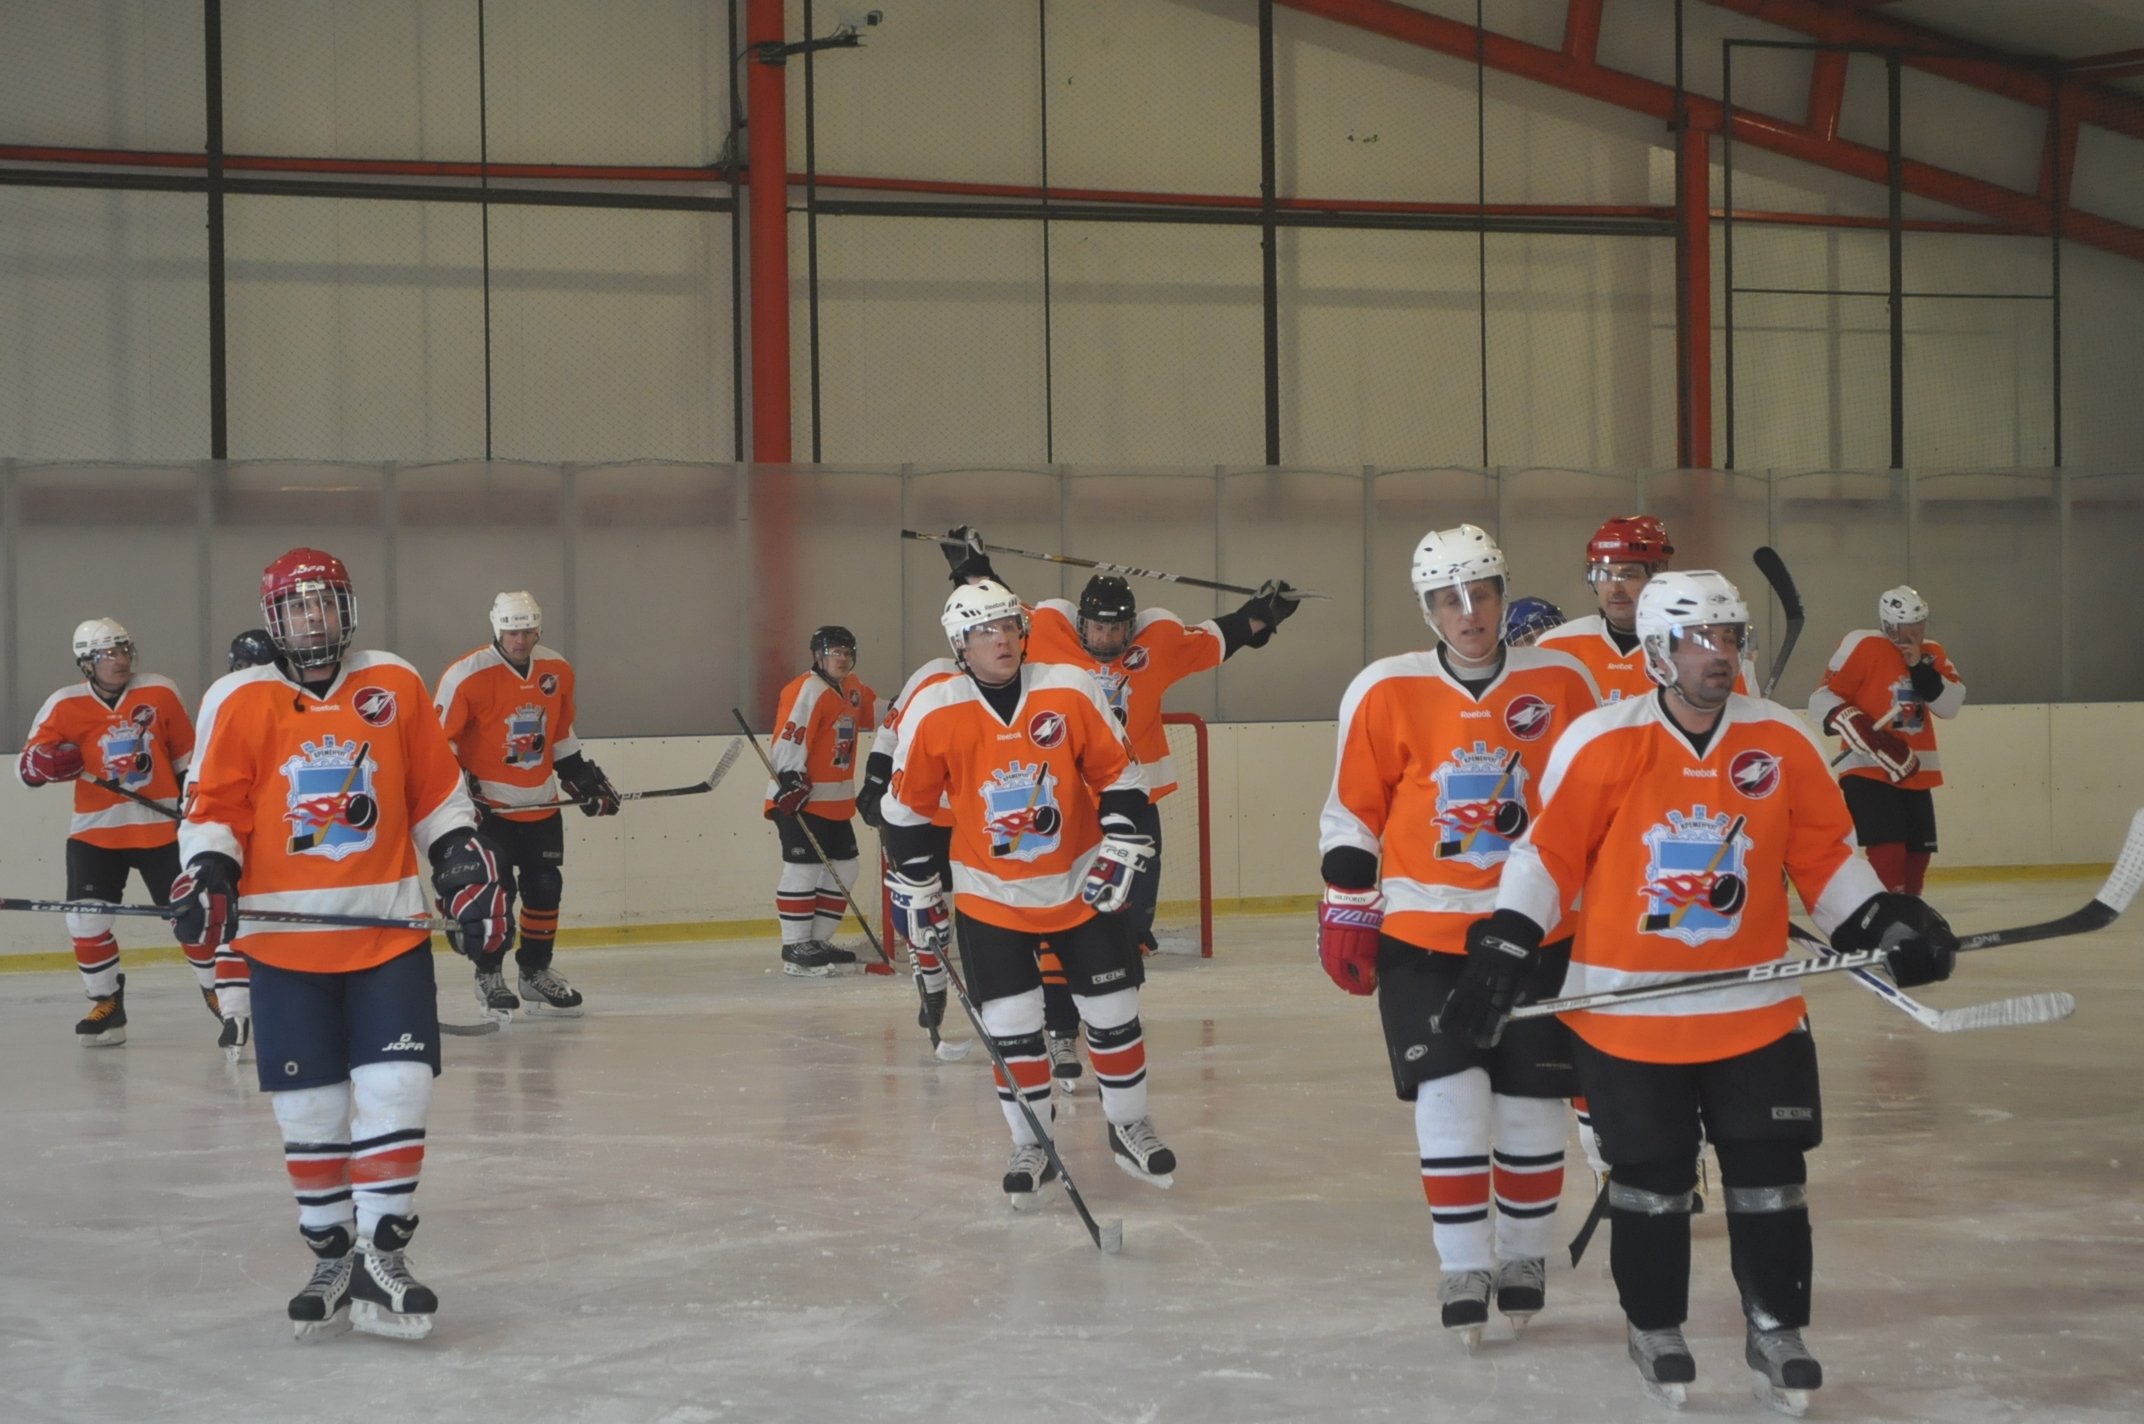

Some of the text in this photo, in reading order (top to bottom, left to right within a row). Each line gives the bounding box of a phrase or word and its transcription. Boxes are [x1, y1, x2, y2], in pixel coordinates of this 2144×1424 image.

[288, 564, 326, 577] JOFA
[1460, 710, 1492, 719] Reebok
[781, 720, 807, 746] 24
[1683, 767, 1718, 778] Reebok
[381, 1042, 425, 1052] JOFA
